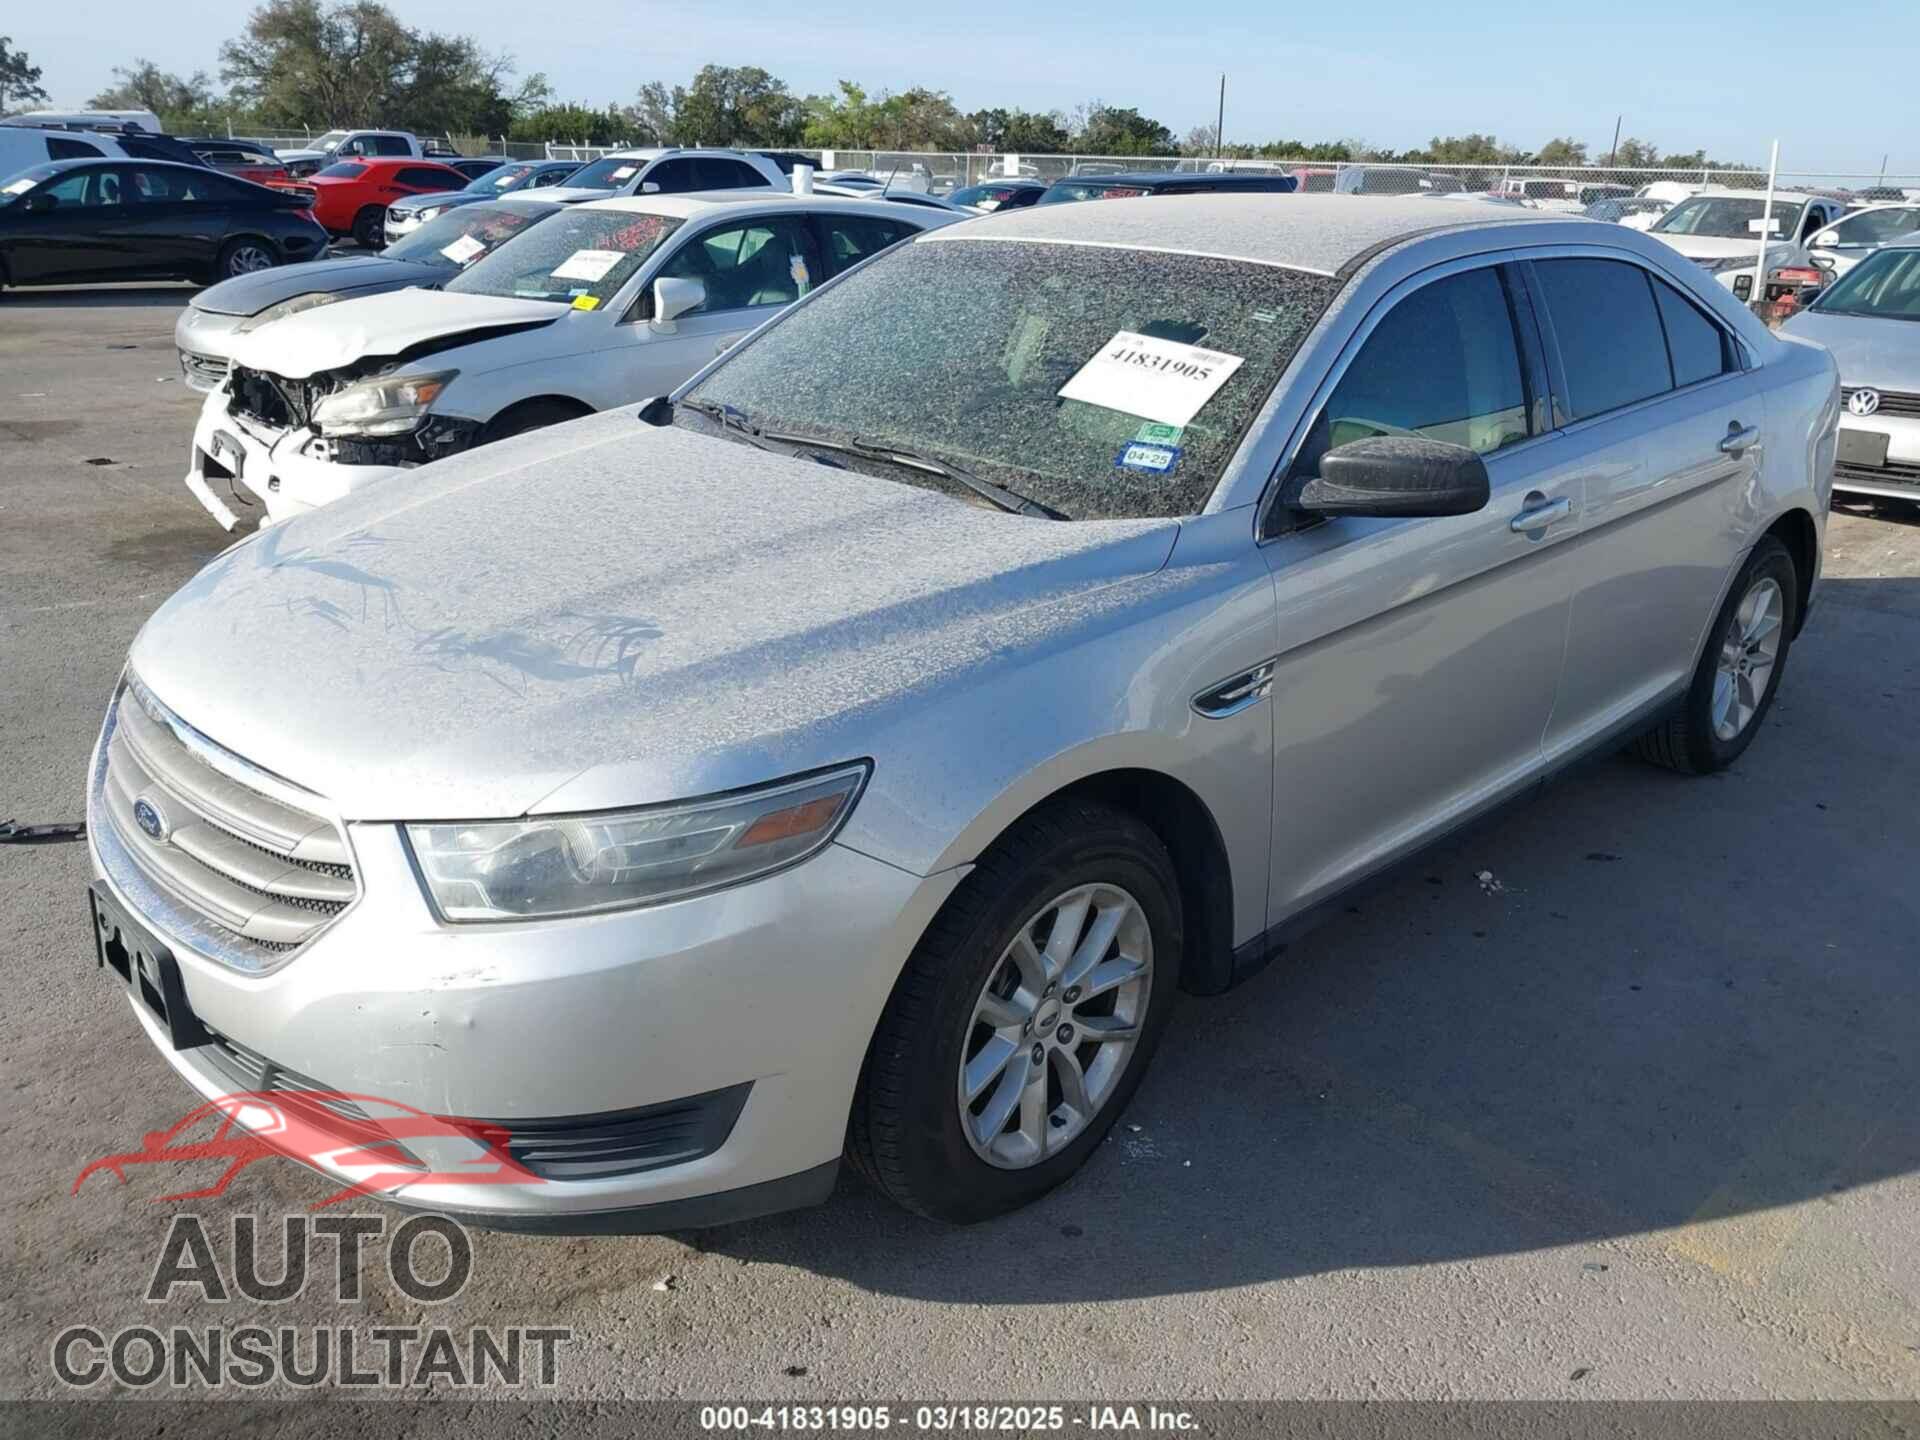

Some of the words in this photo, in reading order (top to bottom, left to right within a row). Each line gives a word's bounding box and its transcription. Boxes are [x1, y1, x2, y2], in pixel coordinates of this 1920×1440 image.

[1110, 348, 1213, 381] 41831905
[1127, 450, 1168, 465] 04-25
[135, 802, 159, 837] Ford
